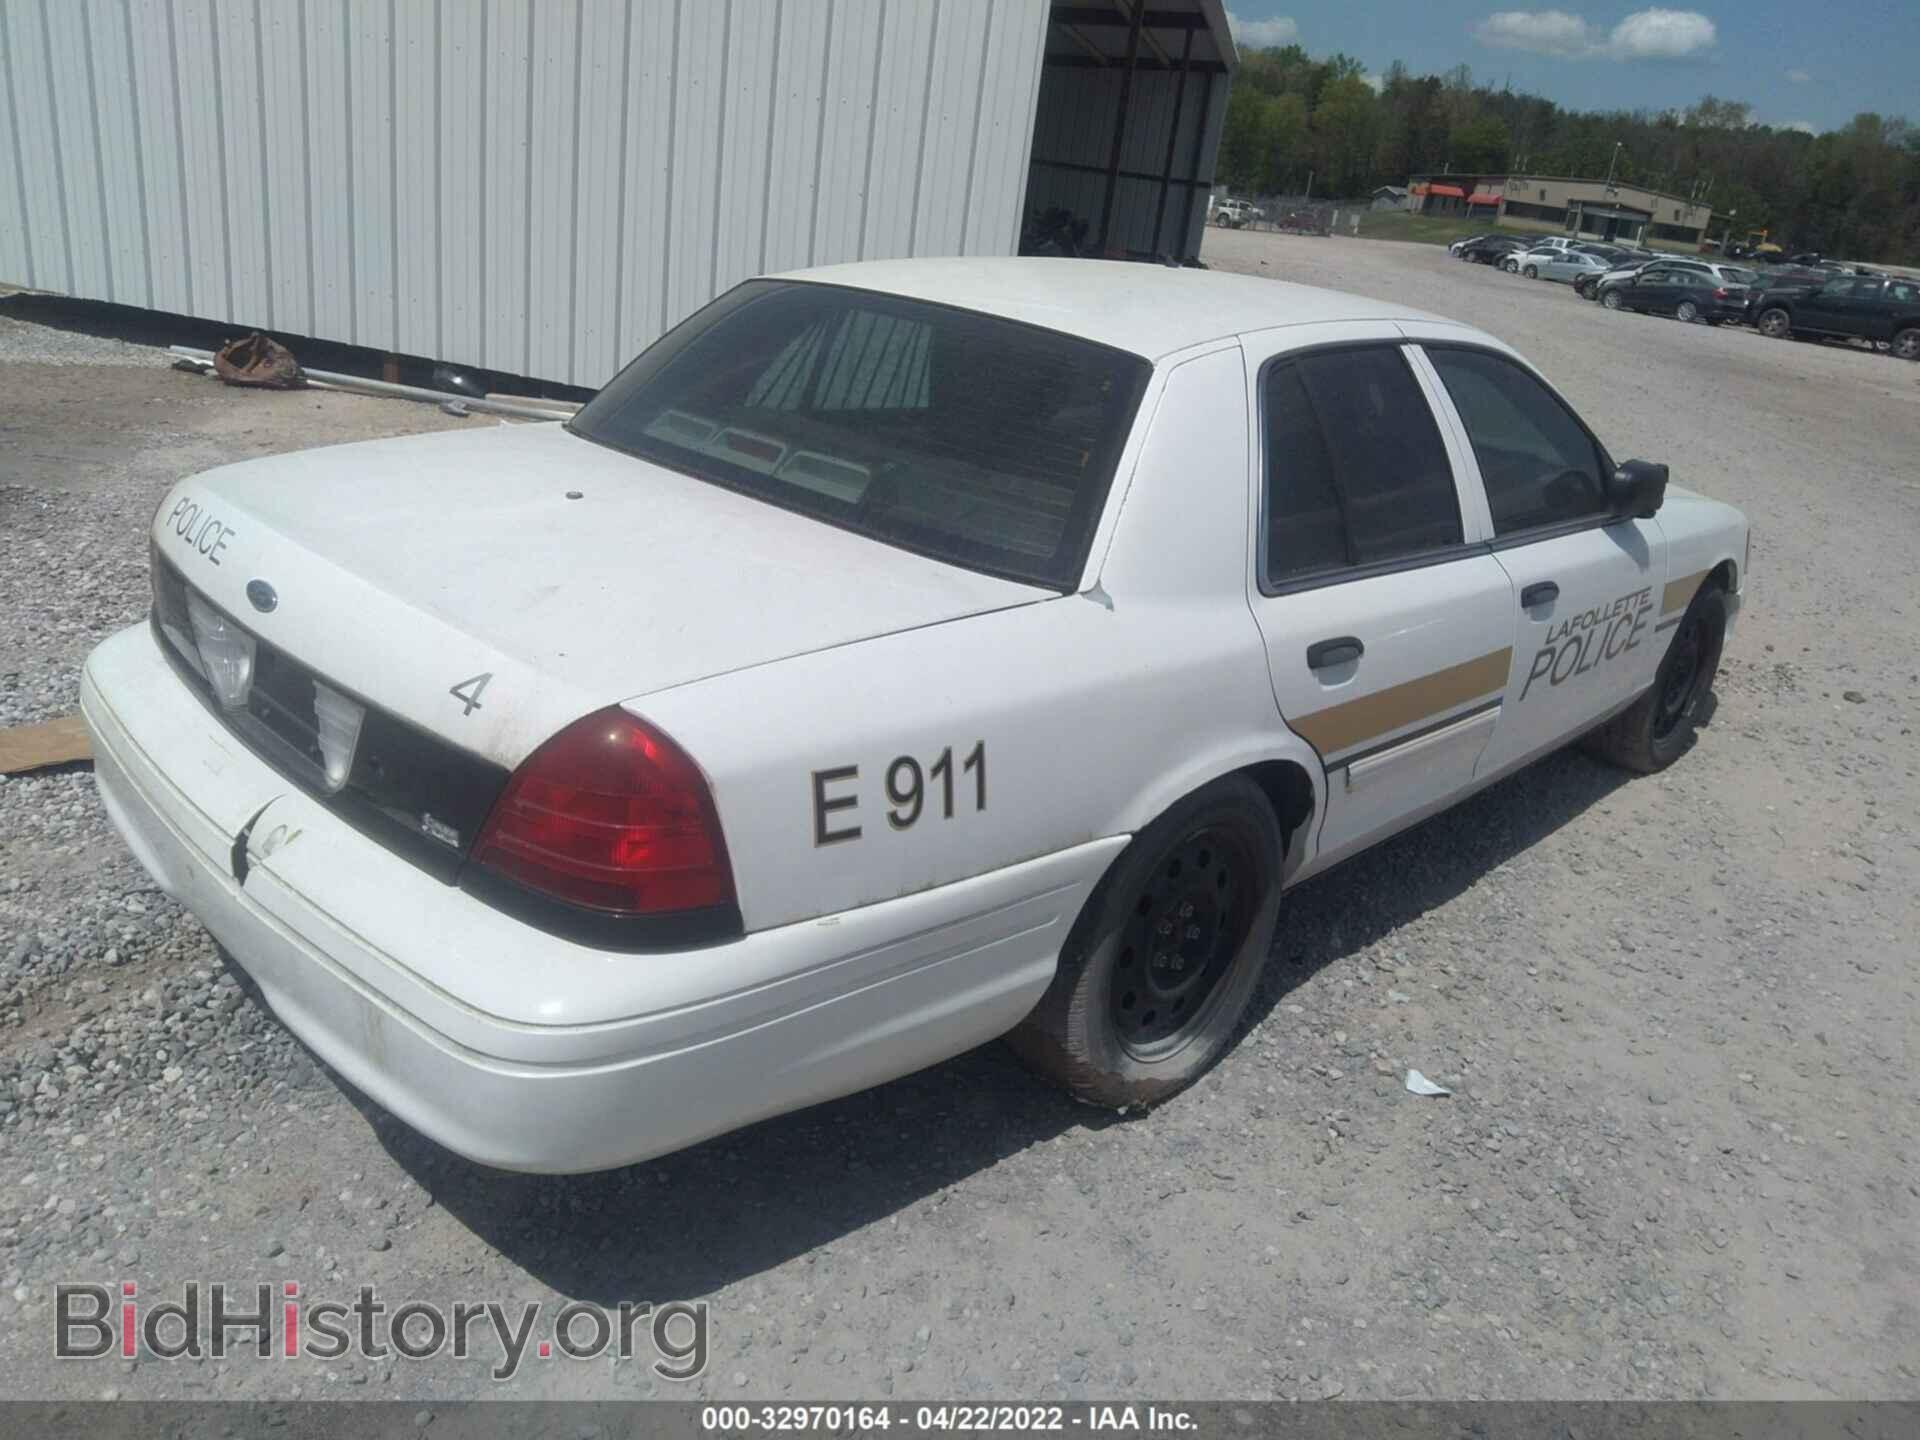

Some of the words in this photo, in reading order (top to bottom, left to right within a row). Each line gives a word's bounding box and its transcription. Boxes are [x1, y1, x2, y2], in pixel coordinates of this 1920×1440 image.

[165, 496, 236, 566] POLICE
[1545, 585, 1653, 644] LAFOLLETTE
[1519, 603, 1653, 702] POLICE
[449, 671, 493, 716] 4
[811, 764, 862, 848] E
[885, 739, 987, 832] 911
